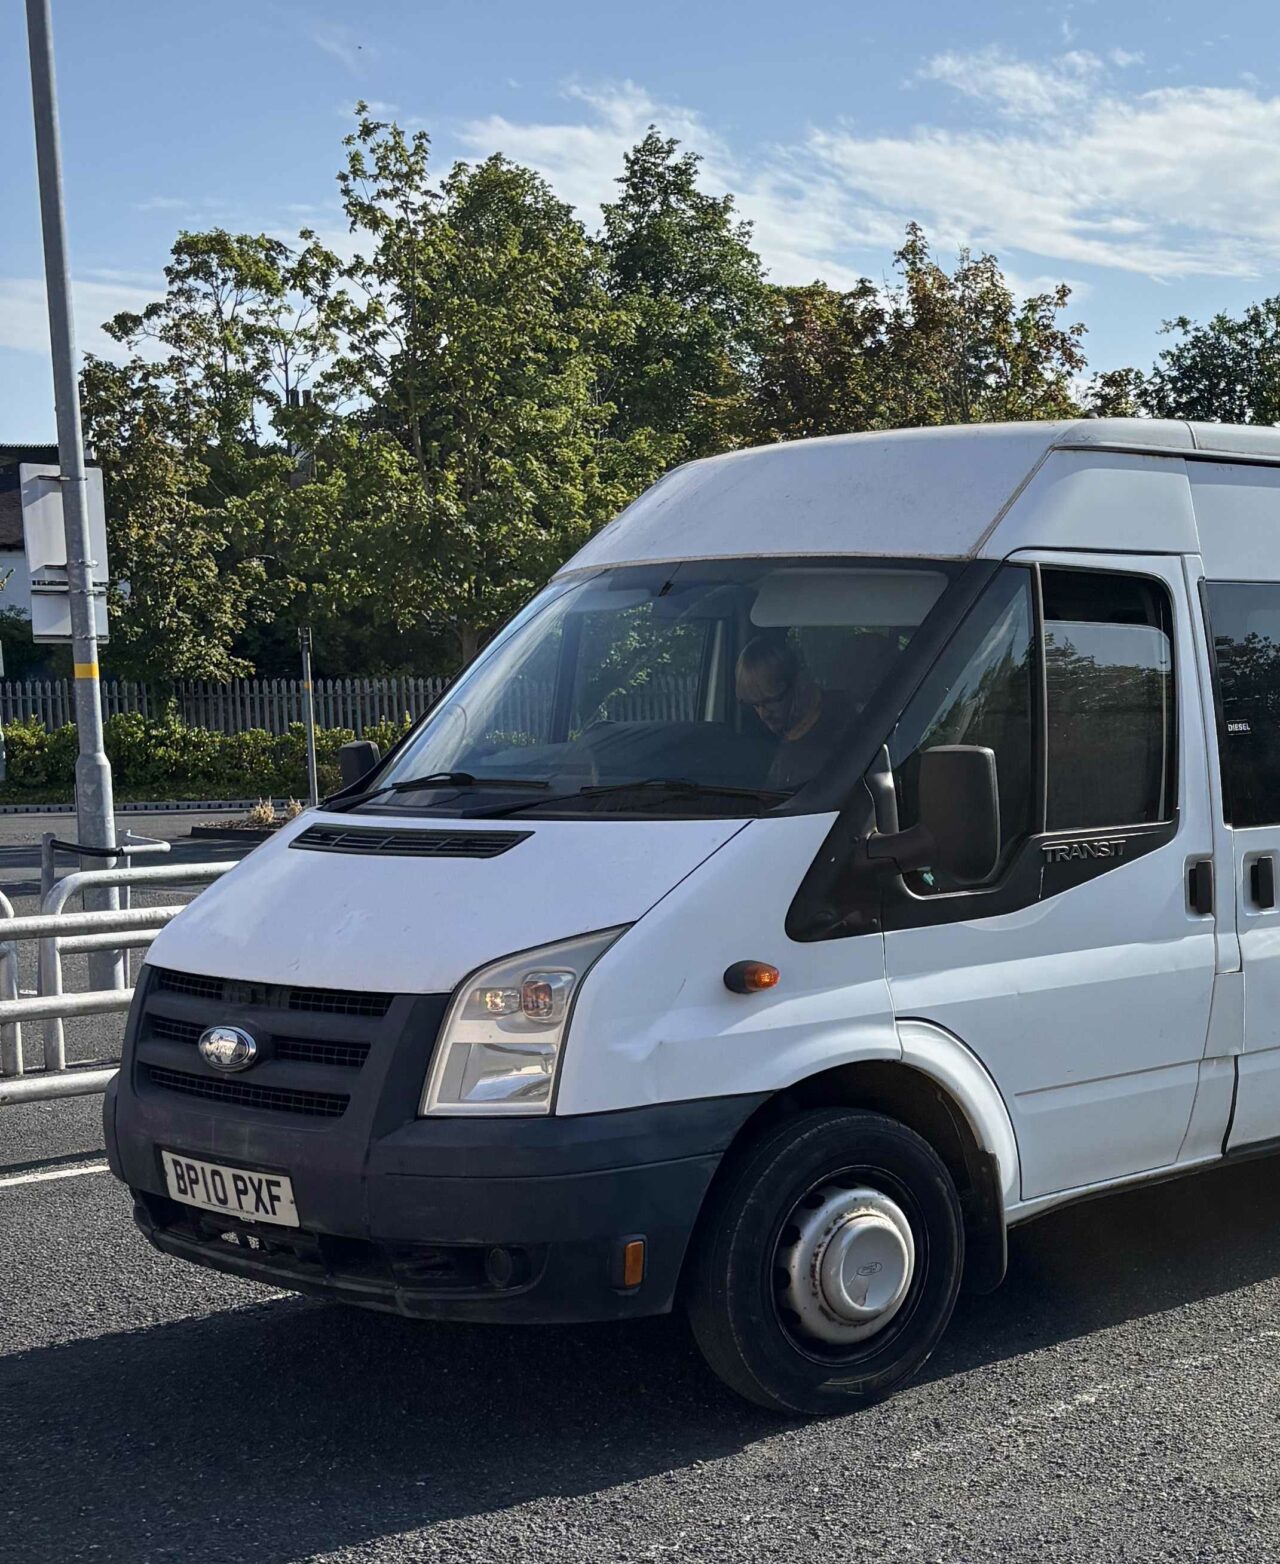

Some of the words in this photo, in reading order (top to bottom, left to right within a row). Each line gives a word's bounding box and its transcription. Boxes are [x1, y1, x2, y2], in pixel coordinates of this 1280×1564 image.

[1227, 722, 1251, 731] DIESEL
[1041, 839, 1127, 863] TRANSIT
[171, 1157, 229, 1206] BP10
[231, 1172, 282, 1217] PXF
